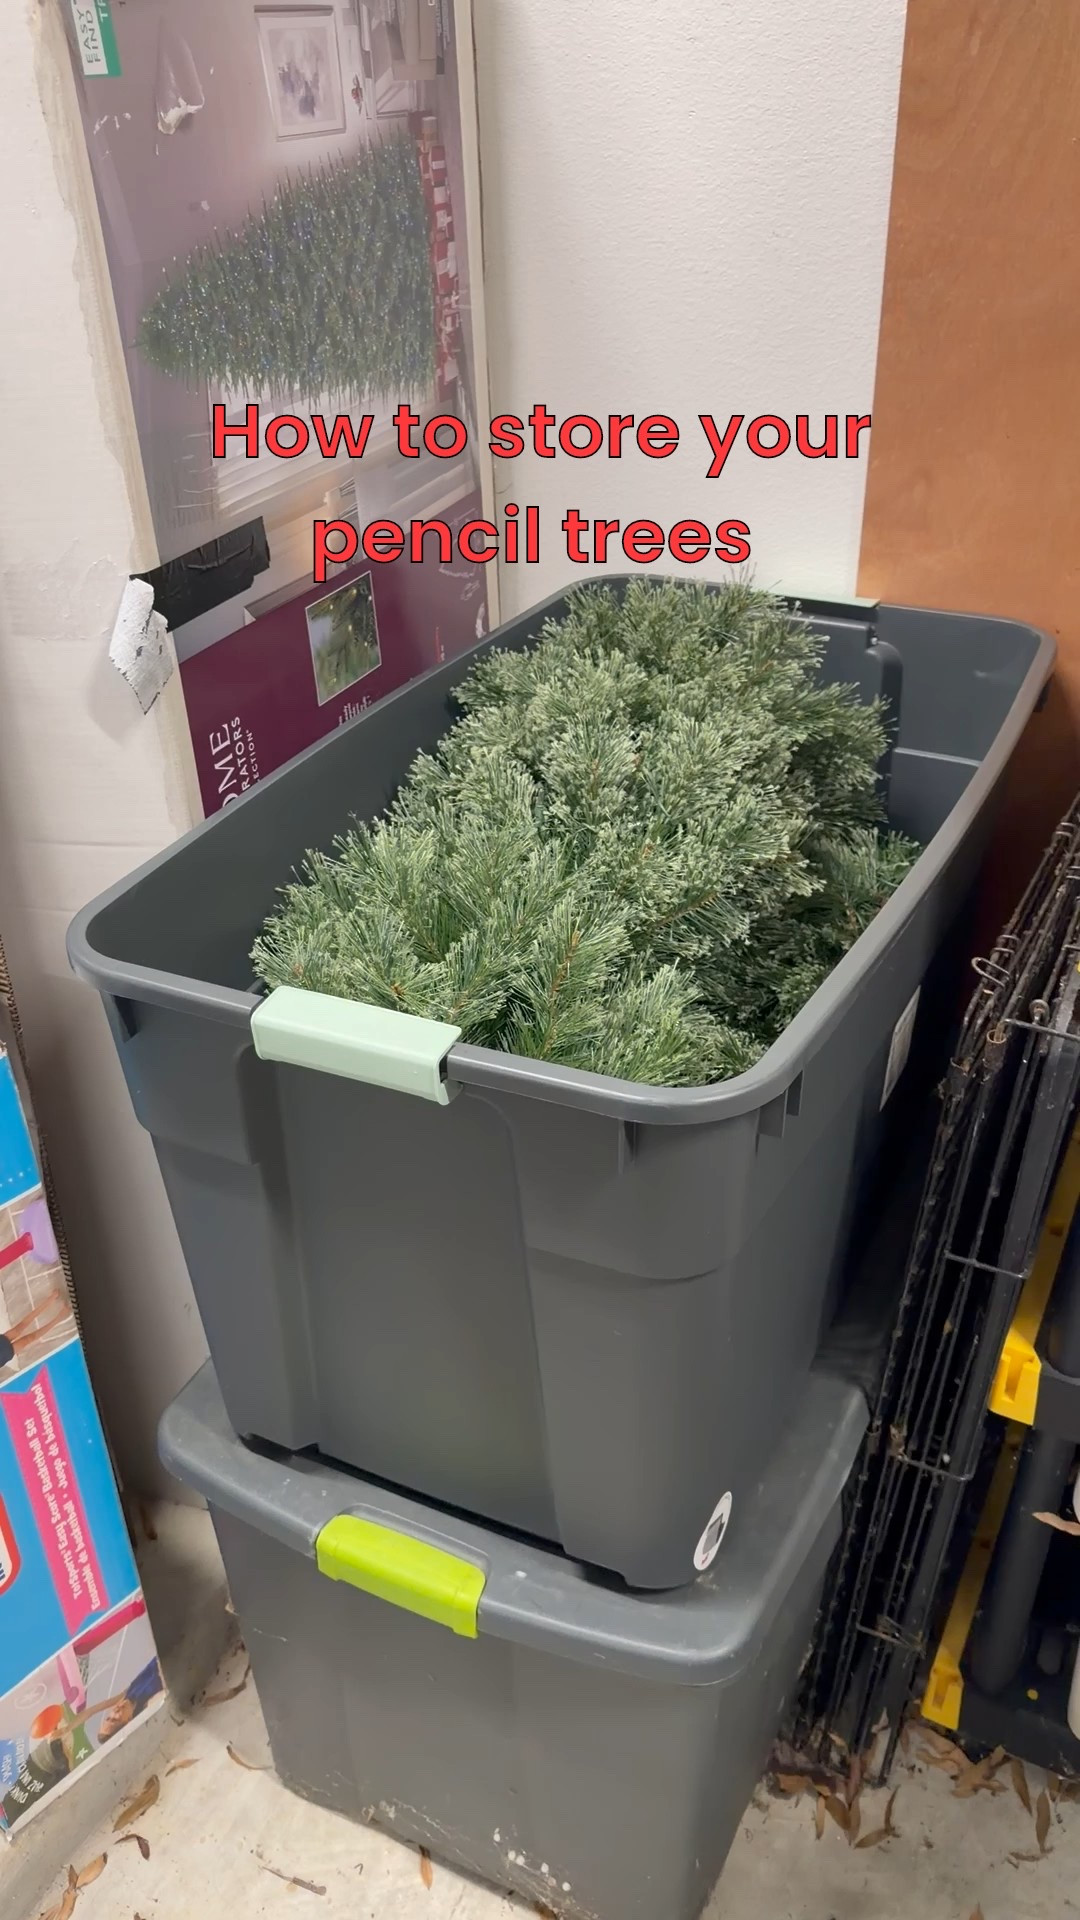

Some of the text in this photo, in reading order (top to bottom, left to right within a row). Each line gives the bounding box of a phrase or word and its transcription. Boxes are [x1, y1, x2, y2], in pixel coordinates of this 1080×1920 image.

[76, 9, 94, 64] EASY
[86, 10, 101, 62] FIND
[231, 716, 251, 791] RATORS
[246, 729, 261, 783] ECTION
[24, 1417, 38, 1438] Set
[48, 1442, 60, 1457] de
[29, 1437, 53, 1493] Basketball
[54, 1458, 68, 1489] Juego
[55, 1520, 68, 1551] Easy
[63, 1500, 85, 1553] basketball
[78, 1549, 89, 1564] de
